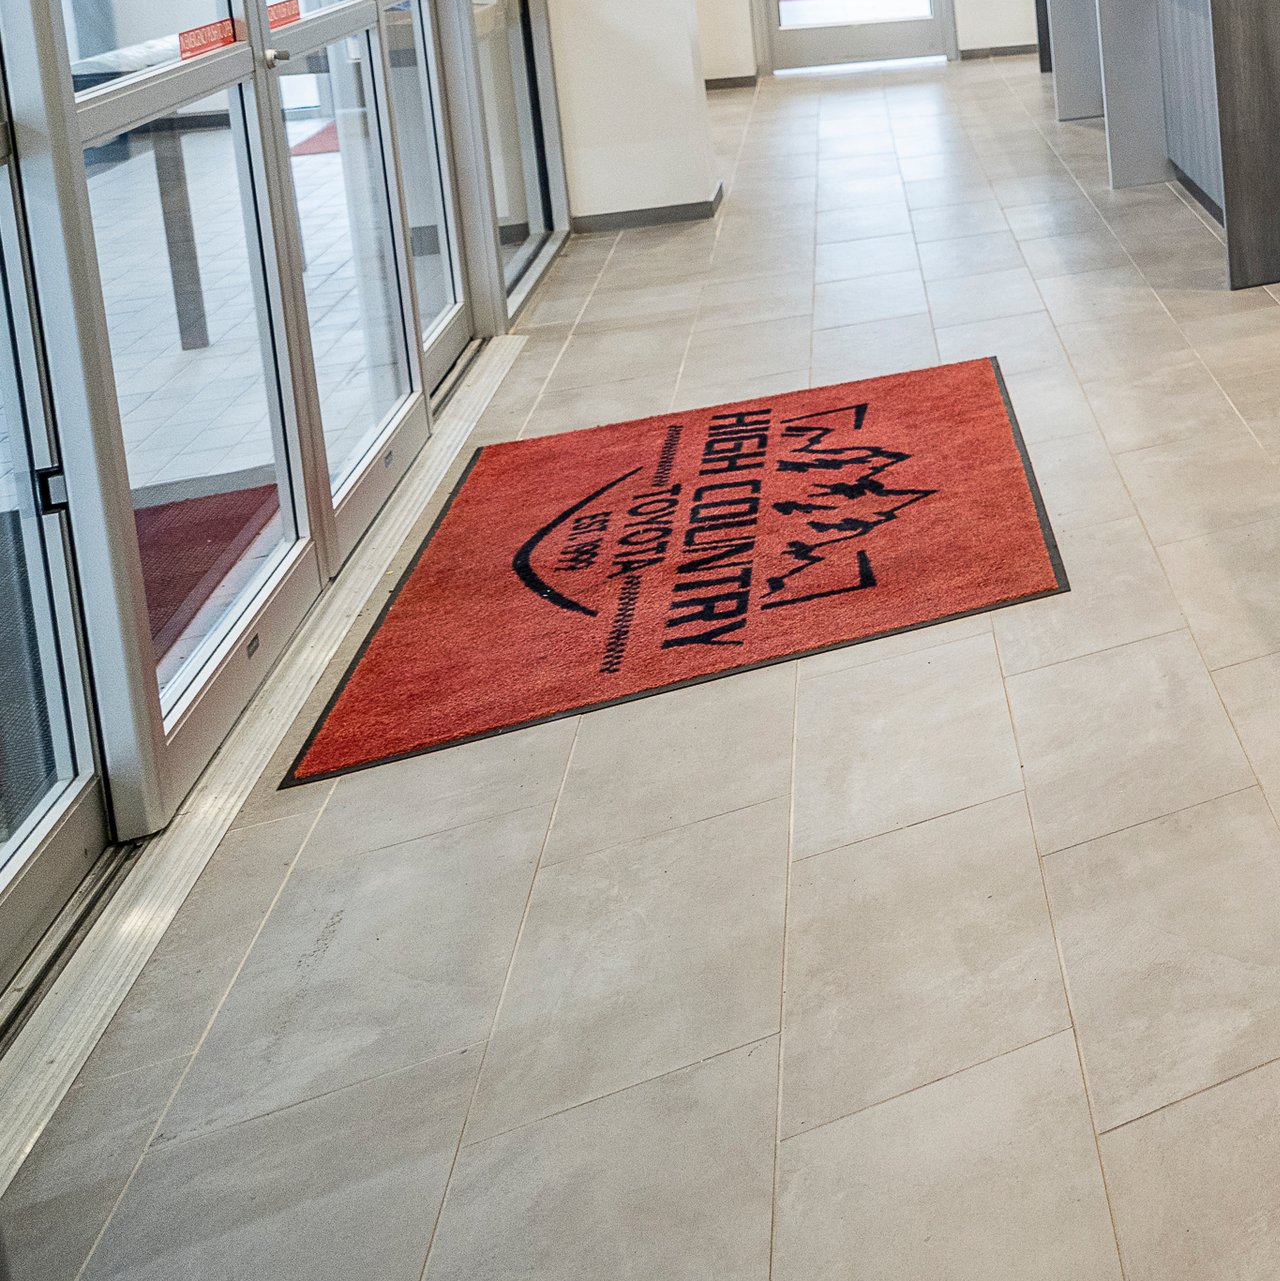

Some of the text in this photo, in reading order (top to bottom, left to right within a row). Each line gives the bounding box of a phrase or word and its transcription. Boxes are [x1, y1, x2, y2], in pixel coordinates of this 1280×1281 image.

[554, 511, 612, 573] EST. 1999
[606, 483, 682, 580] TOYOTA
[661, 408, 773, 650] HIGH COUNTRY
